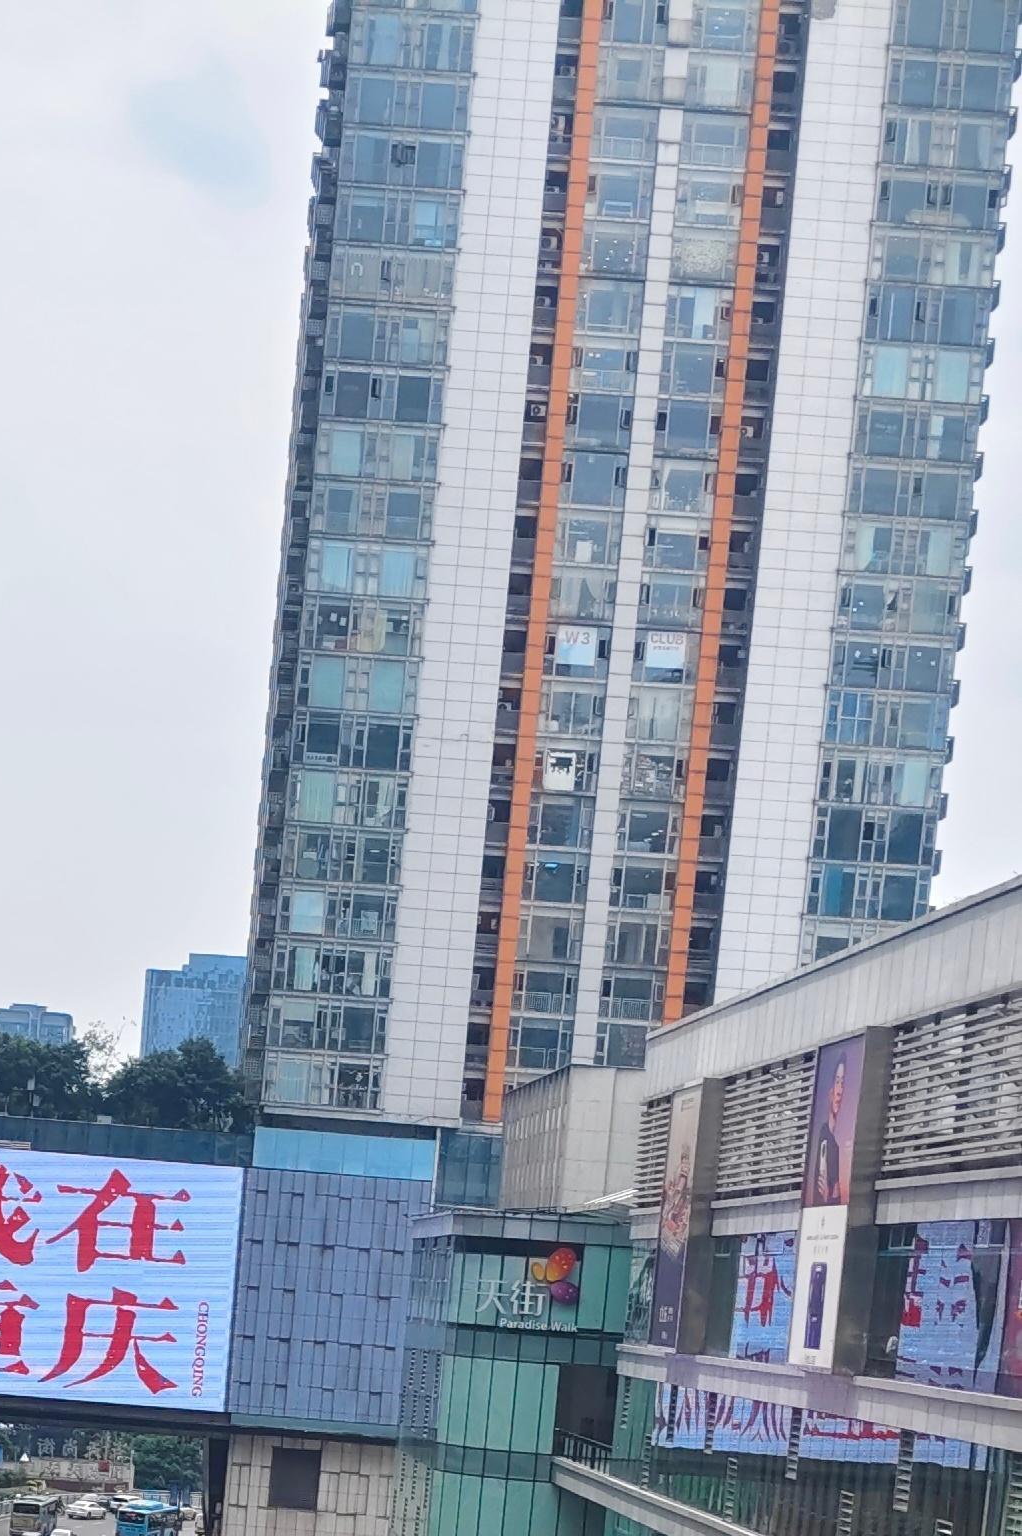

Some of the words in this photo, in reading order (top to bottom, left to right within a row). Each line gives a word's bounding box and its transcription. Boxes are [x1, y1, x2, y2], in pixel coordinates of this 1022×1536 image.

[475, 1279, 549, 1317] 天街
[499, 1317, 548, 1331] Paradise
[550, 1321, 579, 1333] Walk
[191, 1300, 209, 1398] CHONGQING
